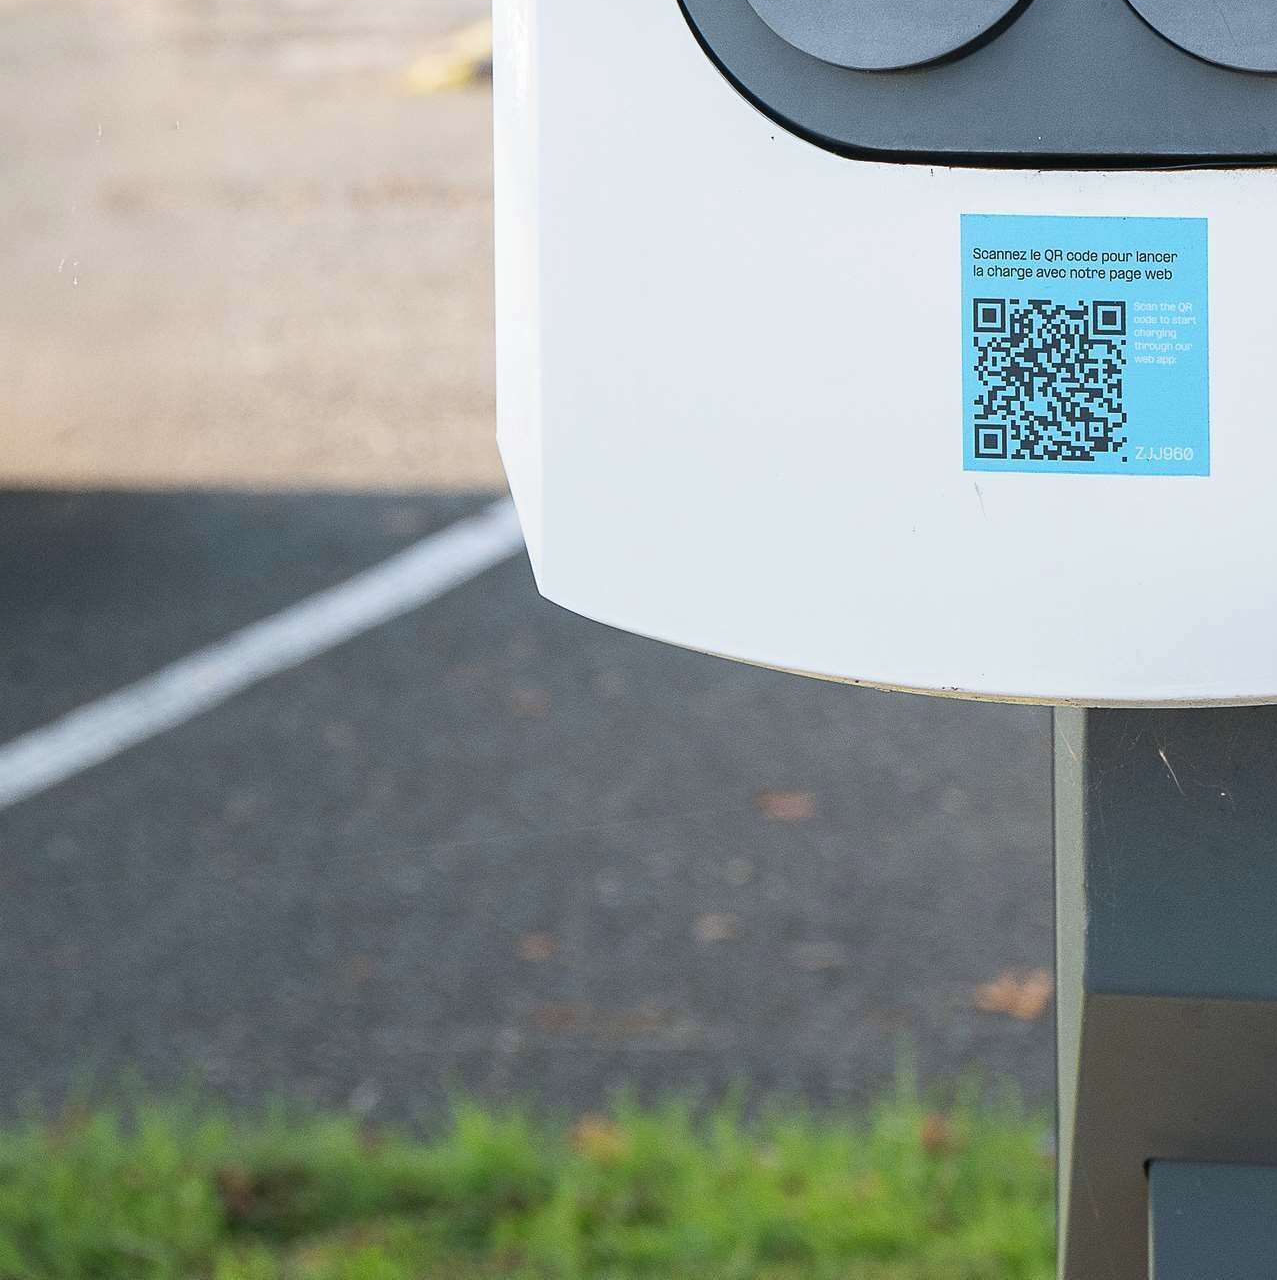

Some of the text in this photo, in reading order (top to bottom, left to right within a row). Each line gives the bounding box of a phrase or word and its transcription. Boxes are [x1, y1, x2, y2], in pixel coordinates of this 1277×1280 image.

[973, 248, 1178, 264] Scannez le QR code pour lancer
[973, 264, 1173, 282] la charge avec notre page web
